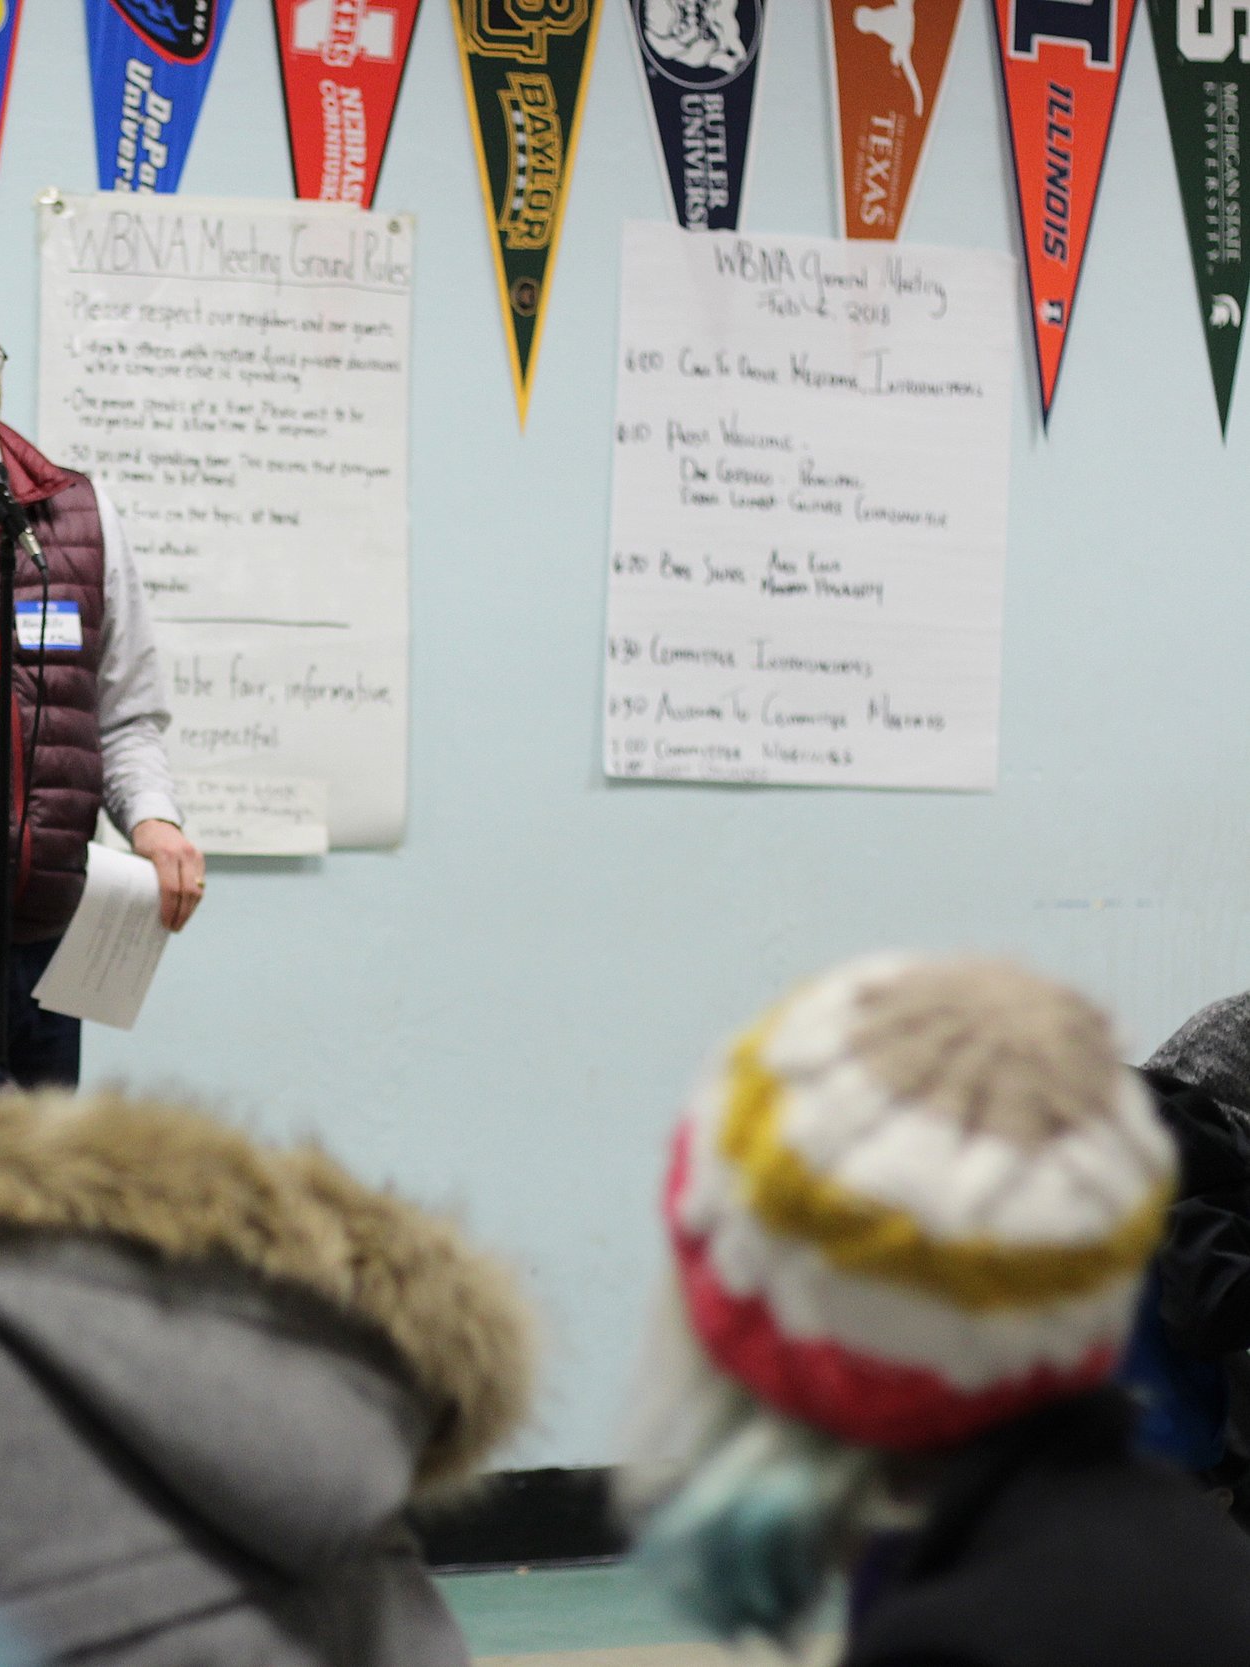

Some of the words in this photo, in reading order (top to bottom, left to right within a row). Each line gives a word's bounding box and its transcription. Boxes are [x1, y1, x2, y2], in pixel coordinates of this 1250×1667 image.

[519, 82, 556, 240] BAYLOR
[704, 94, 729, 208] BUTLER
[860, 115, 896, 226] TEXAS
[1043, 82, 1074, 266] ILLINOIS
[1203, 81, 1220, 263] UNIVERSITY
[1223, 81, 1240, 197] MICHIGAN
[67, 210, 190, 274] WBNA
[202, 217, 281, 288] Meeting
[289, 222, 356, 281] Ground
[363, 229, 409, 286] Rules
[1224, 200, 1241, 264] STATE
[140, 295, 202, 331] respect
